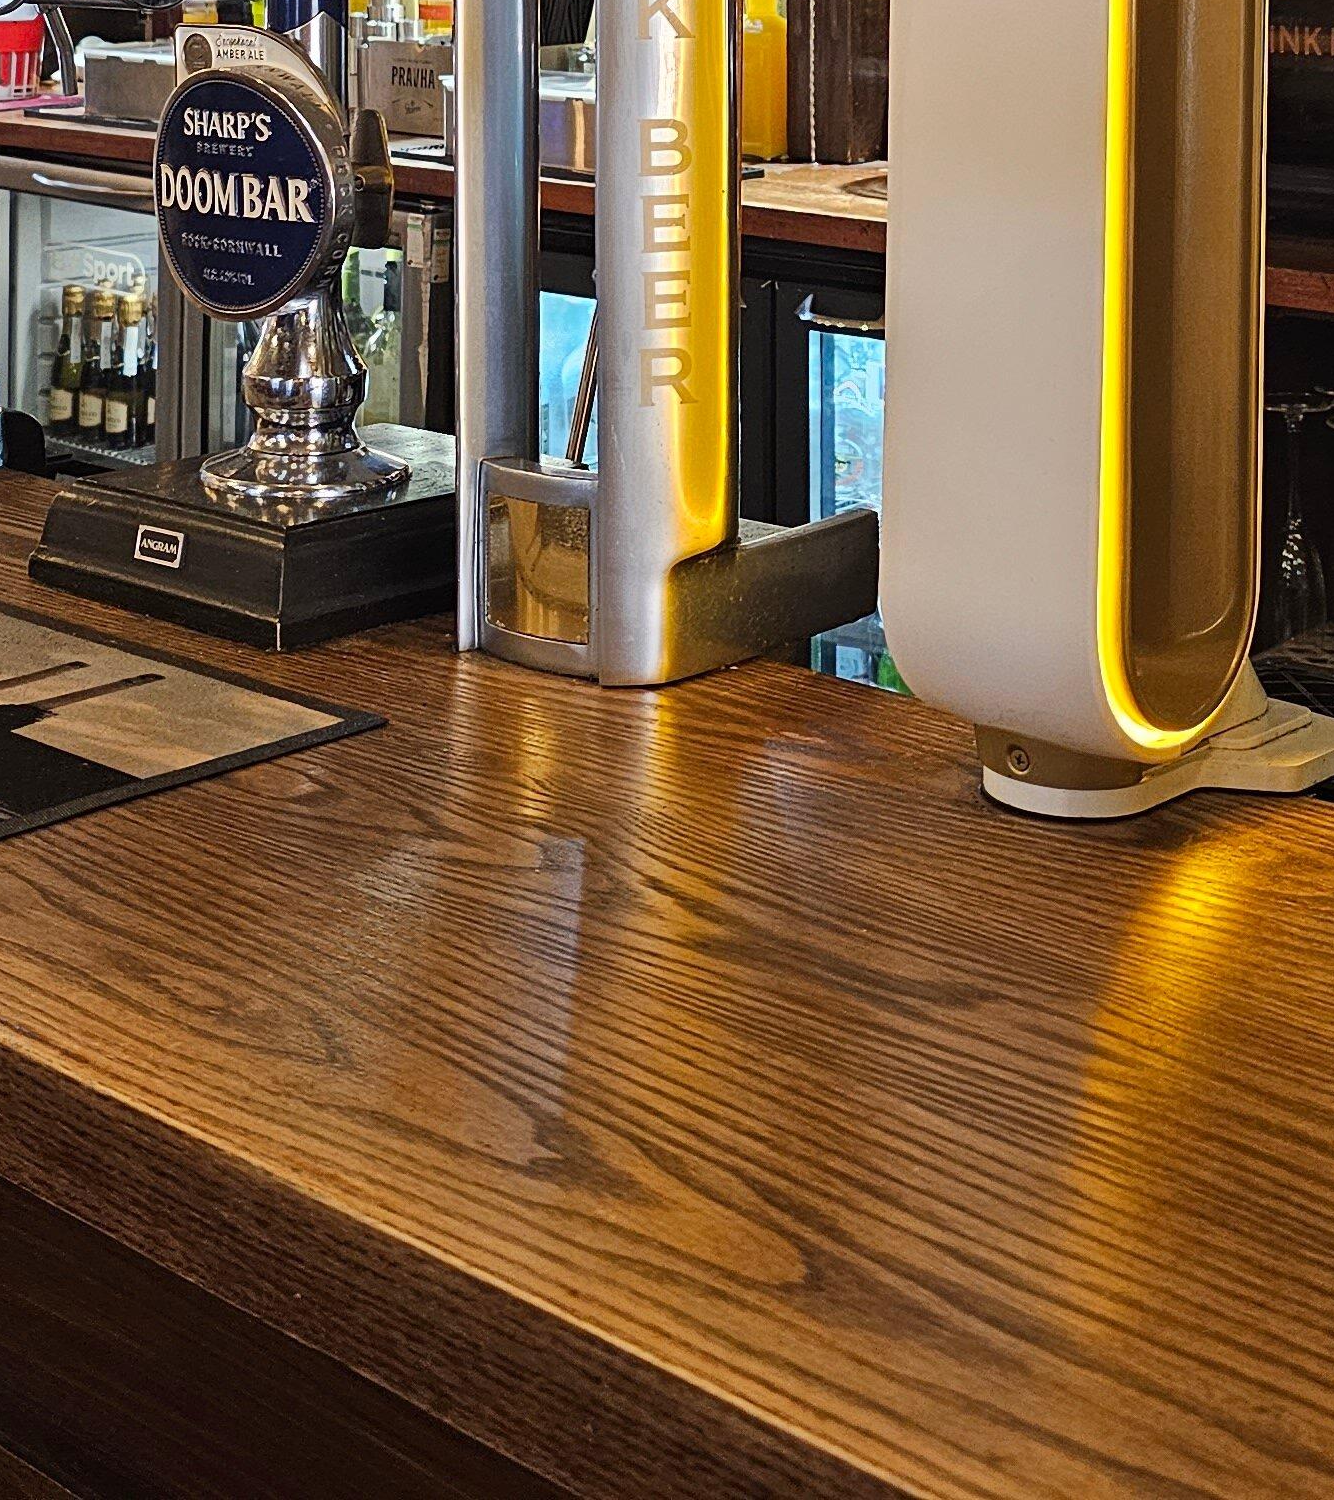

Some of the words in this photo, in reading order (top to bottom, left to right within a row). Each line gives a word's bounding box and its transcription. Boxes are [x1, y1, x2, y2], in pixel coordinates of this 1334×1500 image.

[216, 48, 245, 60] AMBER
[247, 50, 265, 61] ALE
[1270, 25, 1323, 56] INK
[391, 65, 436, 90] PRAVHA
[183, 107, 273, 142] SHARP'S
[160, 163, 237, 217] DOOM
[83, 254, 136, 290] Sport
[637, 118, 699, 408] BEER
[141, 538, 177, 555] ANGRAM
